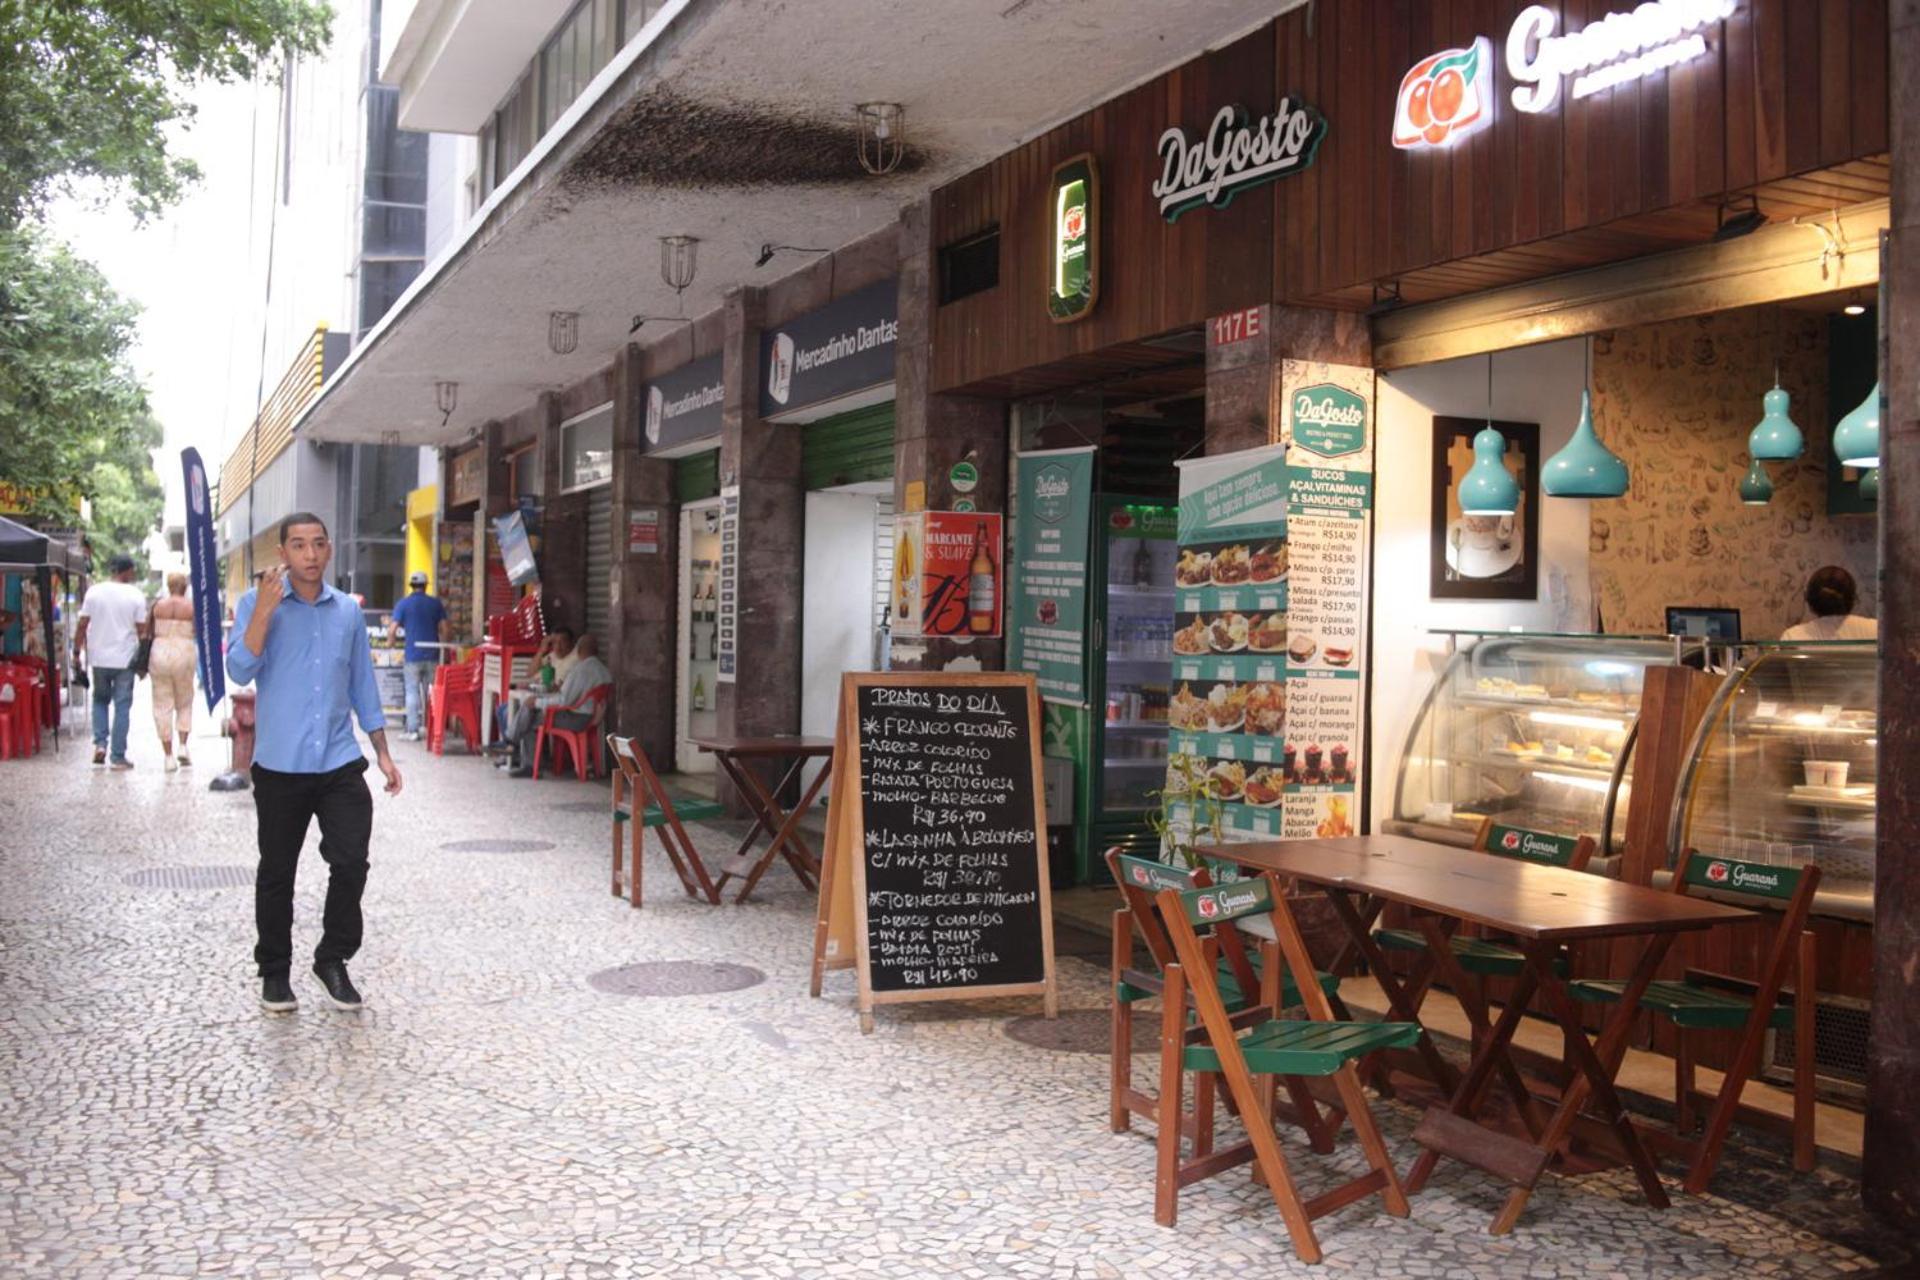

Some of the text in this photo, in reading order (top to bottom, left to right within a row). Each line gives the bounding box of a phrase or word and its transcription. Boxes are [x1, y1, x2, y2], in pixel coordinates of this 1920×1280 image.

[1152, 97, 1313, 216] DaGosto
[795, 333, 856, 374] Mercadinho
[857, 319, 898, 352] Dantas
[702, 381, 724, 407] Danta
[1295, 395, 1363, 427] DaGosto
[1311, 469, 1345, 481] SUCOS
[1294, 542, 1321, 551] Frango
[1291, 613, 1319, 624] Frango
[936, 693, 962, 712] DO
[1732, 864, 1779, 886] Guaraná
